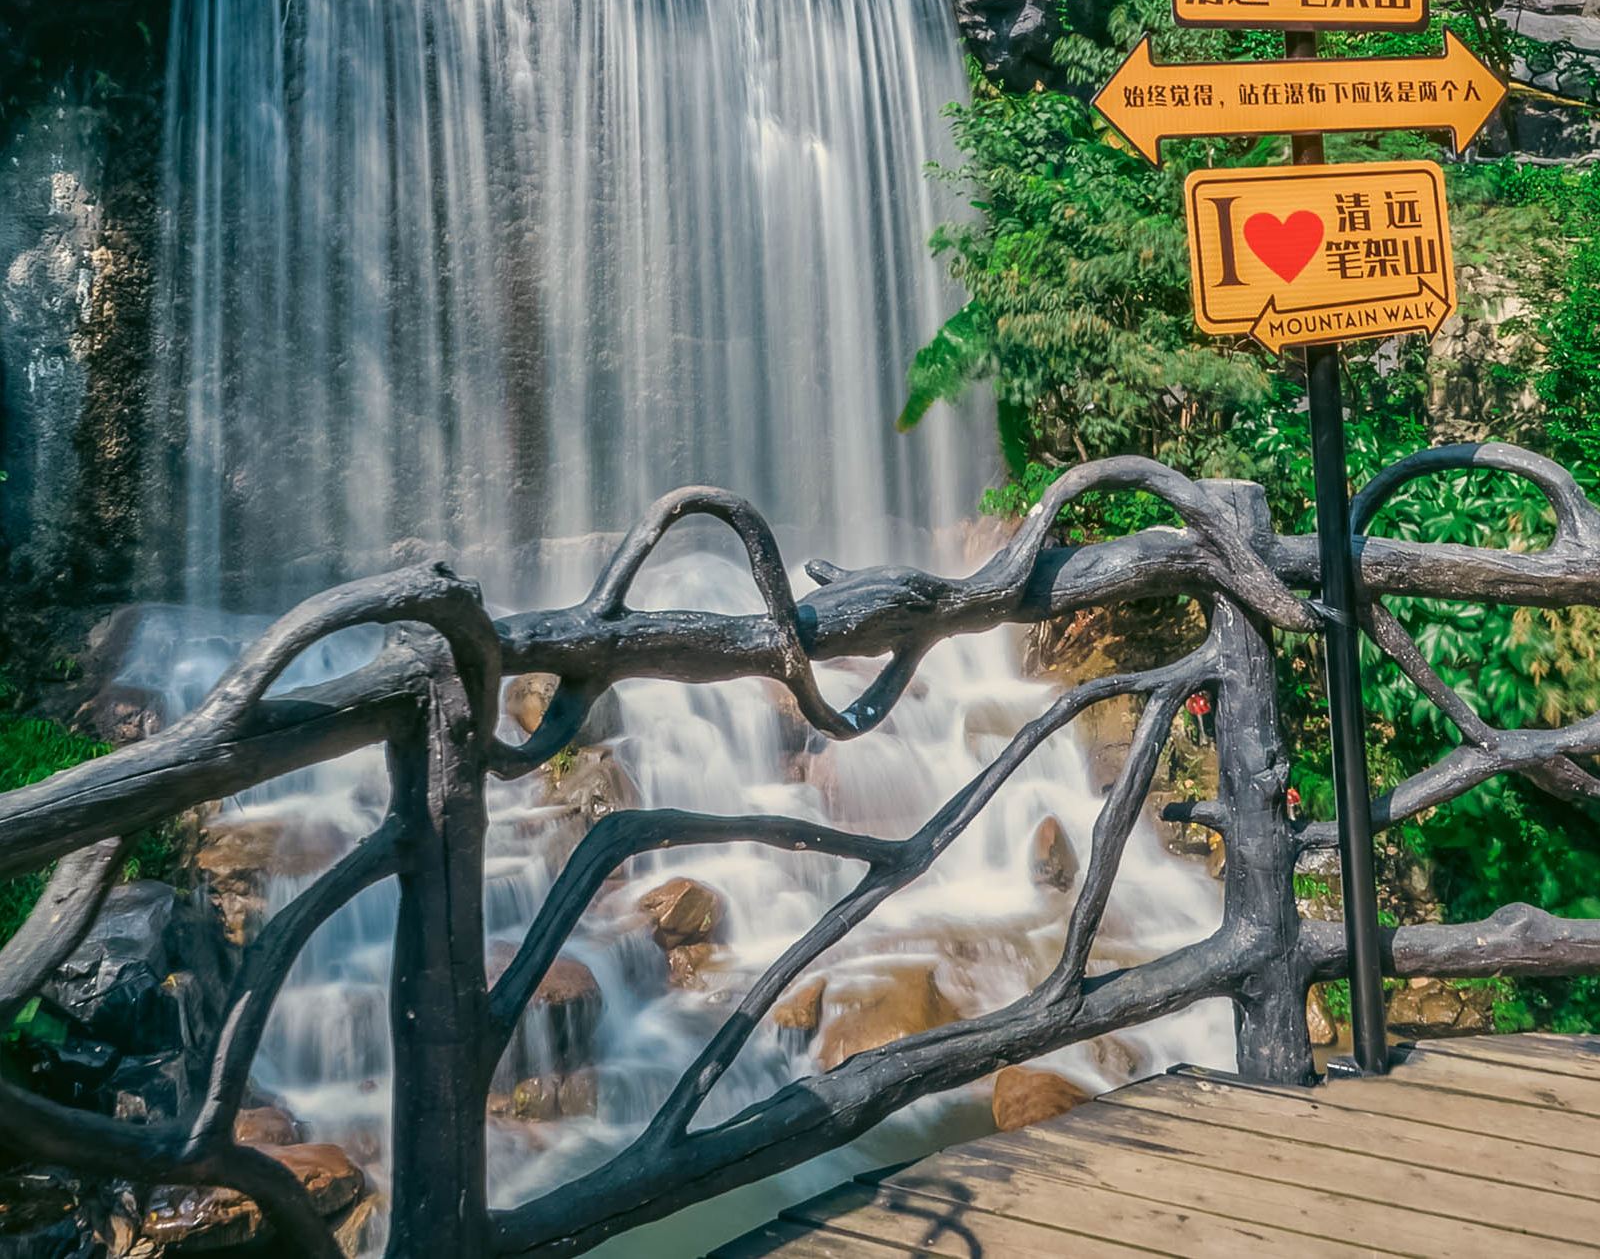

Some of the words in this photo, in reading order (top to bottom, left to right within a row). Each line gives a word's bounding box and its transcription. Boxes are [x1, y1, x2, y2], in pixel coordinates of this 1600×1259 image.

[1203, 196, 1250, 287] I
[1325, 236, 1438, 279] 笔架山
[1269, 308, 1378, 337] MOUNTAIN
[1383, 301, 1437, 322] WALK
